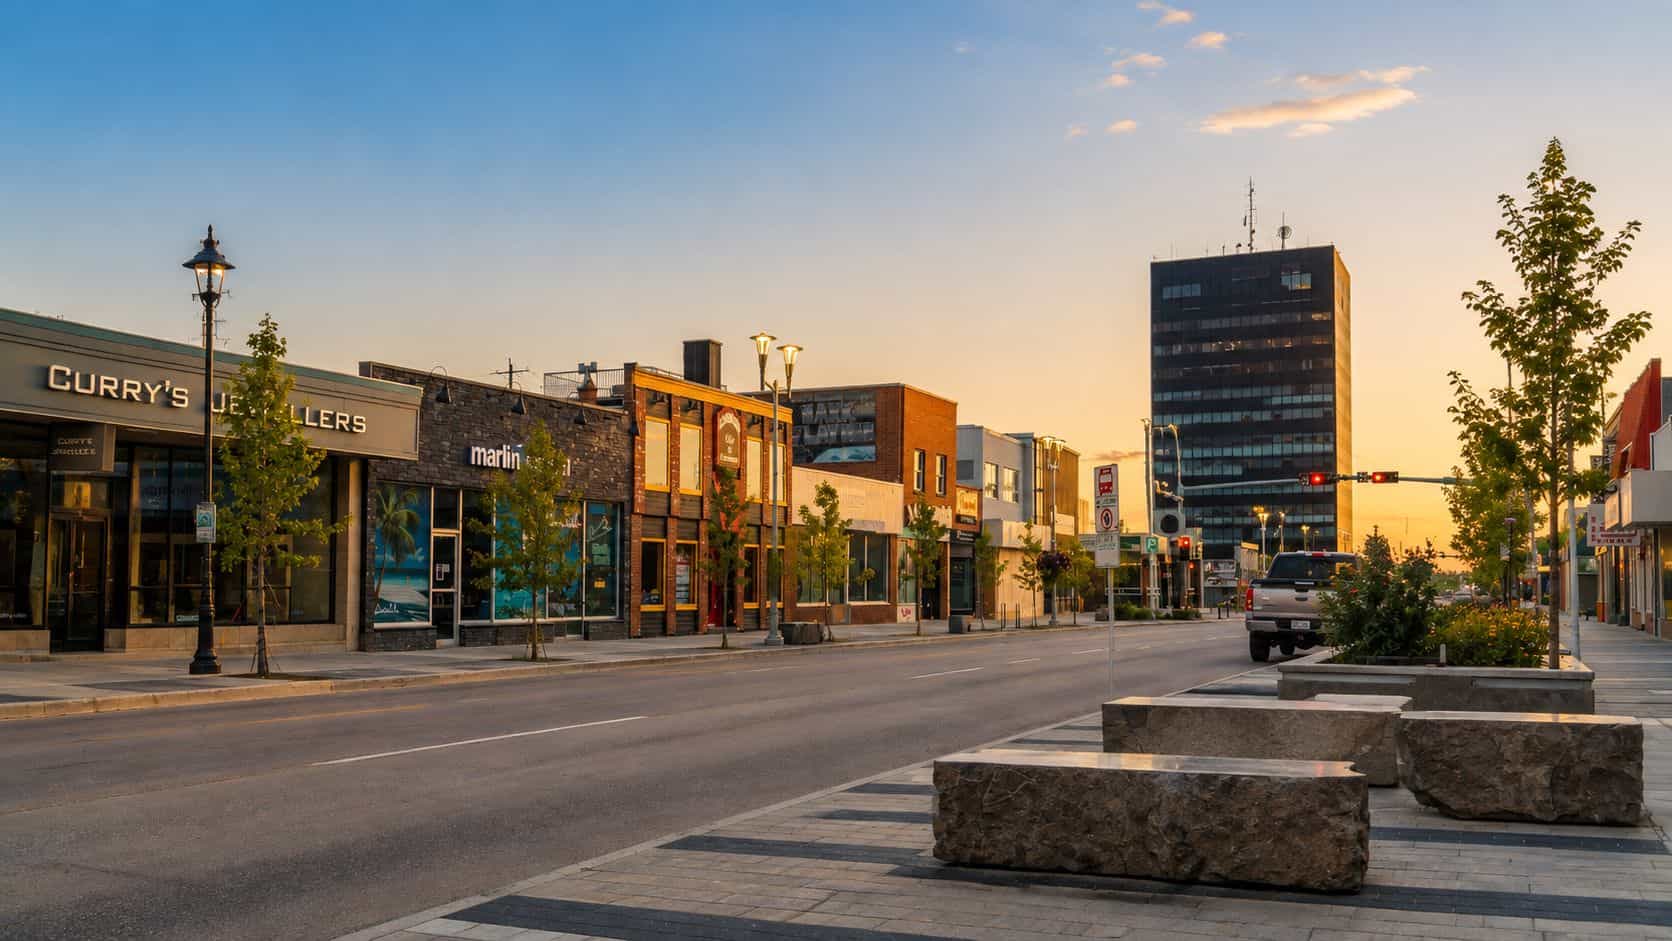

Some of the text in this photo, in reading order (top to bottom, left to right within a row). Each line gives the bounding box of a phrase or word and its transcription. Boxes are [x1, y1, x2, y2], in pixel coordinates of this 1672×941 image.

[48, 364, 367, 433] CURRY'S JELLERS
[471, 444, 521, 470] marlin
